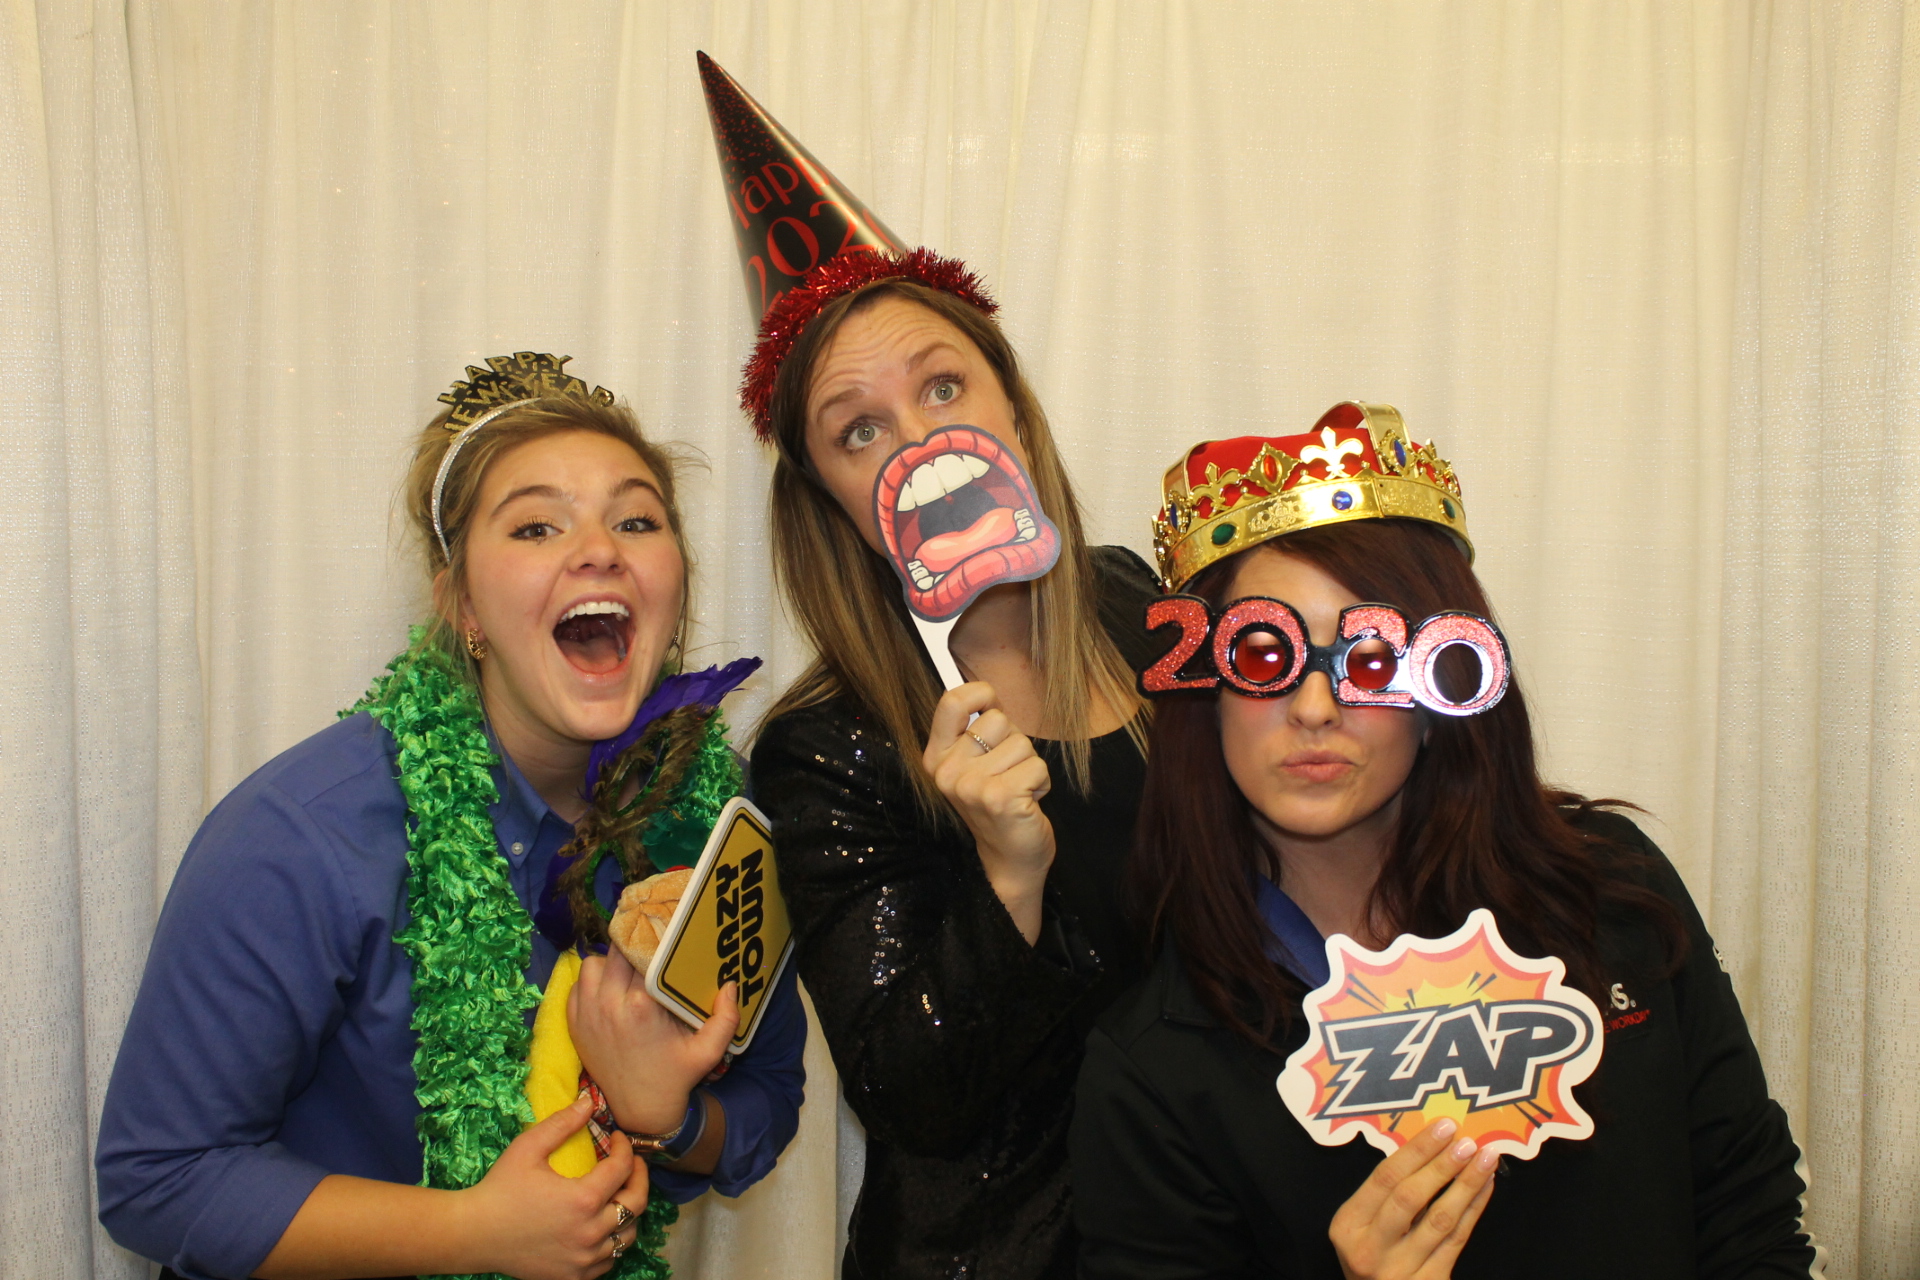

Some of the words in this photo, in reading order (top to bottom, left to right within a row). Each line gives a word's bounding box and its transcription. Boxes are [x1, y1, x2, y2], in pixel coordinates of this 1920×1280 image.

[438, 352, 573, 402] HAPPY
[1136, 593, 1511, 716] 2020
[716, 863, 740, 1003] RAZY
[741, 848, 763, 1008] TOWN
[1313, 999, 1594, 1121] ZAP
